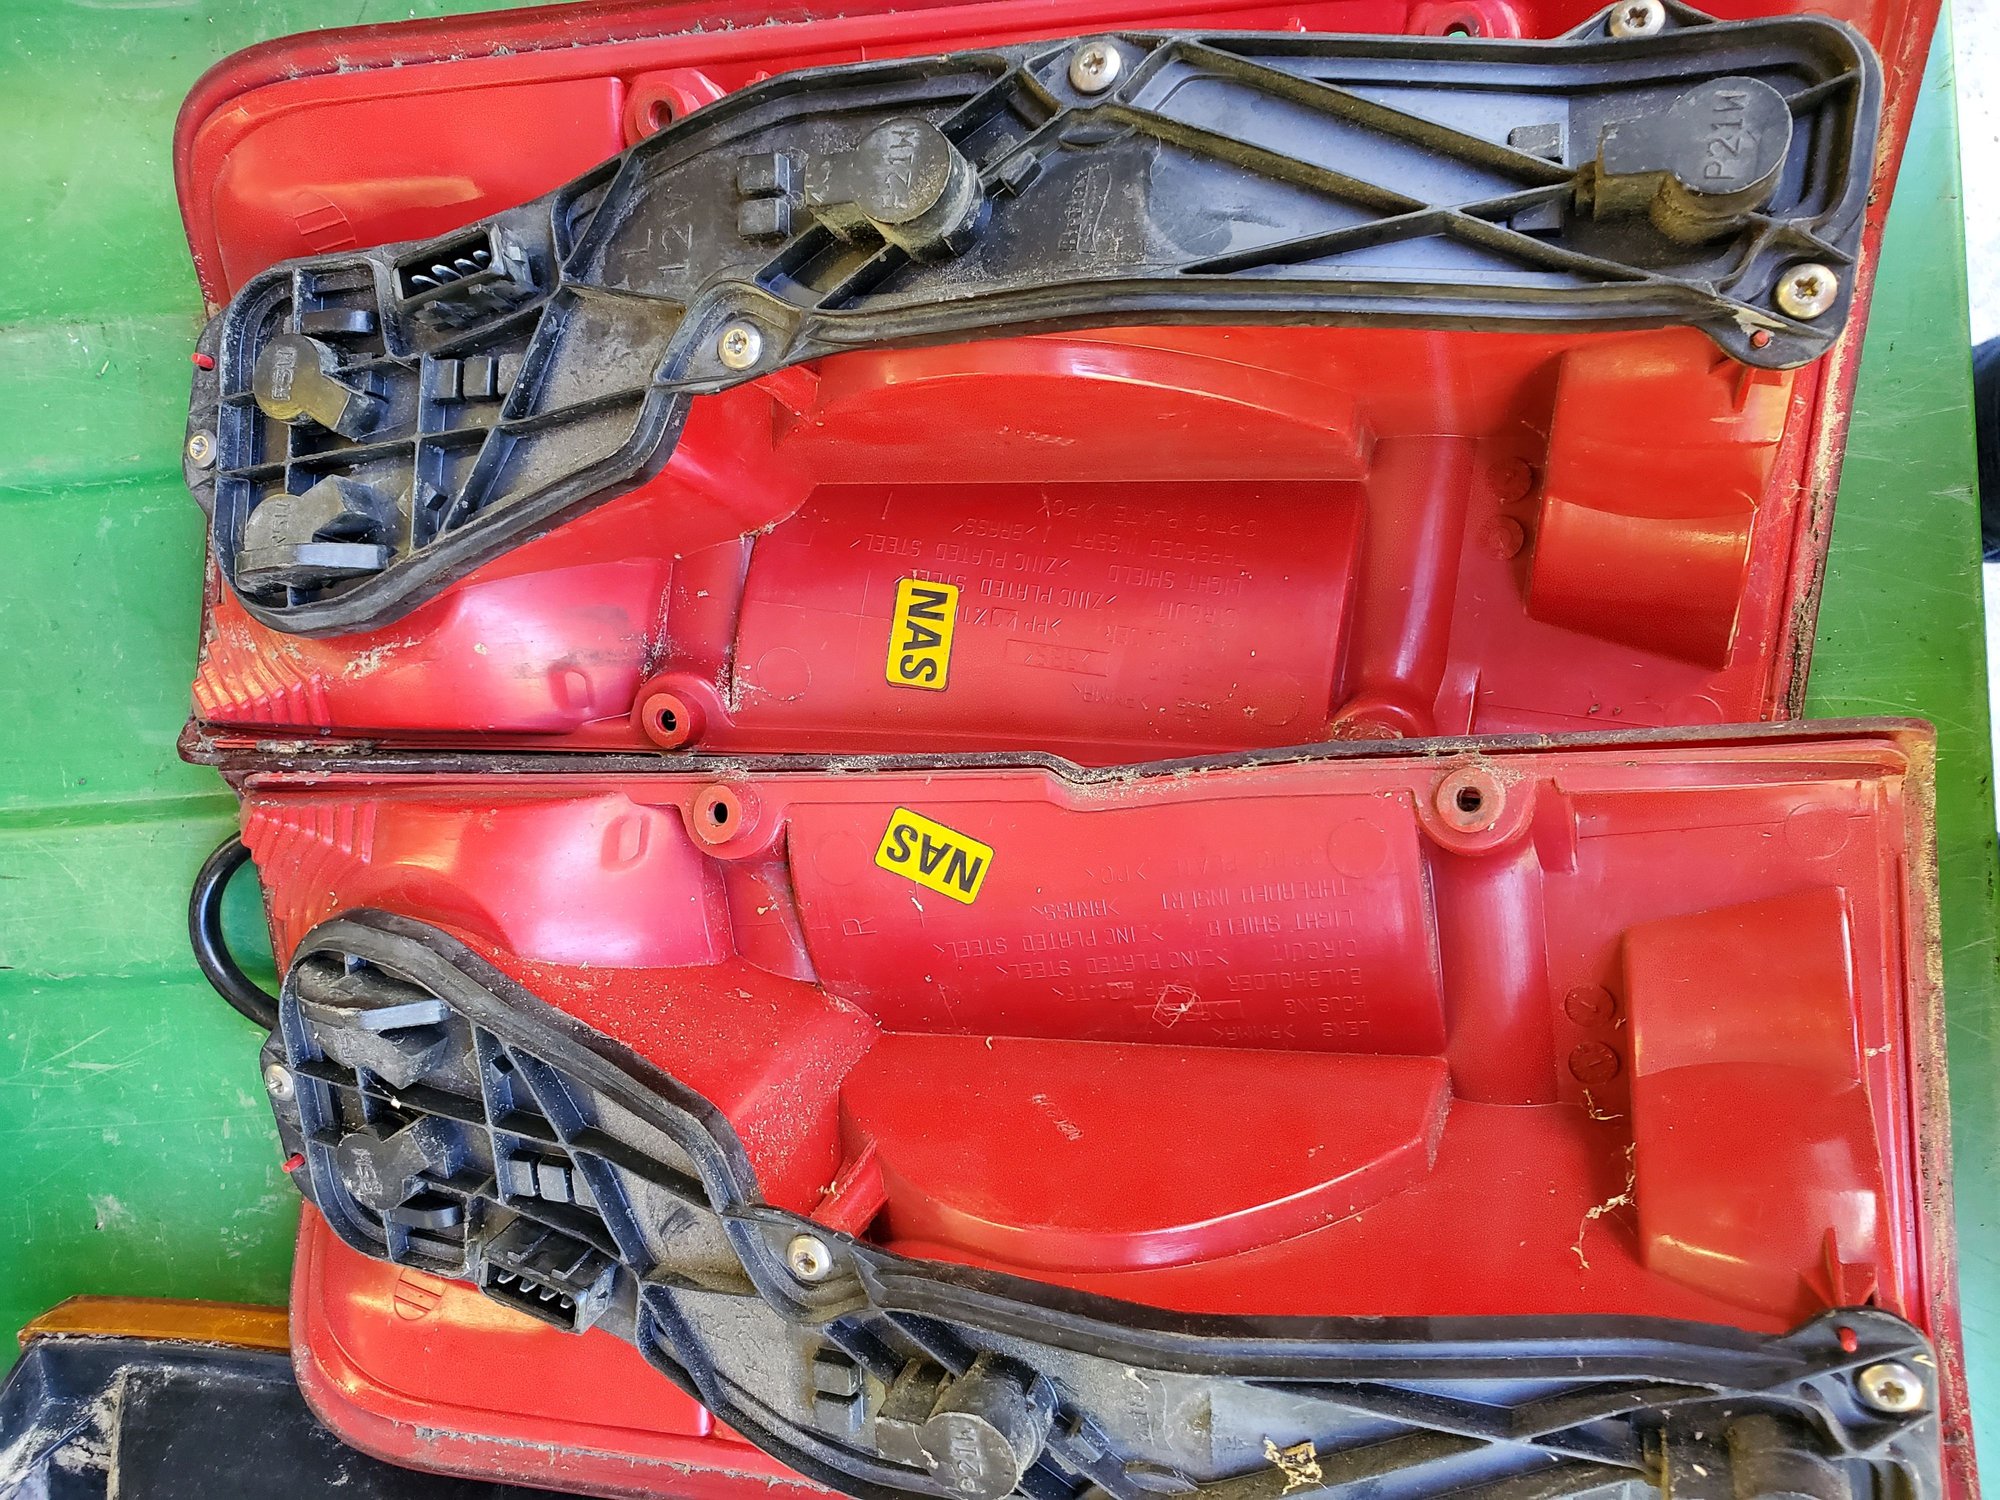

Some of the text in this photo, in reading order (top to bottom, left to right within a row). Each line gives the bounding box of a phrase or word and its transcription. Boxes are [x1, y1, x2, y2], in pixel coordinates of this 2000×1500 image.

[1703, 90, 1747, 179] P21W
[936, 543, 1007, 568] PLATED
[1107, 563, 1176, 589] SHIELD
[1184, 574, 1242, 598] LIGHT
[979, 578, 1053, 604] PLATED
[899, 588, 948, 682] NAS
[886, 824, 982, 893] NAS
[1208, 913, 1281, 937] SHIELD
[1295, 908, 1354, 931] LIGHT
[1021, 928, 1097, 953] PLATED
[1271, 938, 1357, 962] CIRCUIT
[1086, 952, 1161, 975] PLATED
